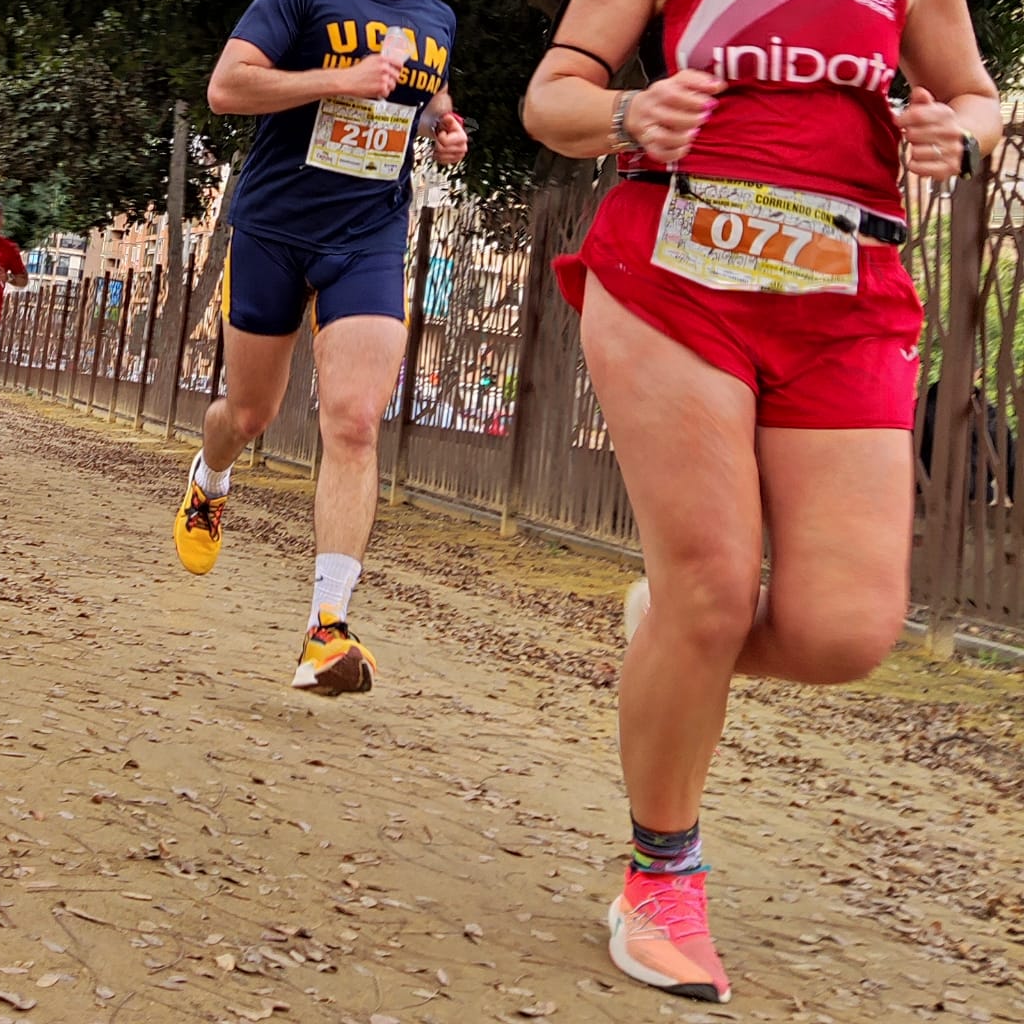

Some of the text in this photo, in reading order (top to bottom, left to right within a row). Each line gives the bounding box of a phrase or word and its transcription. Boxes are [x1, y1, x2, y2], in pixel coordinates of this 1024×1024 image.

[341, 124, 389, 151] 210
[755, 194, 812, 218] CORRIENDO
[710, 212, 813, 265] 077
